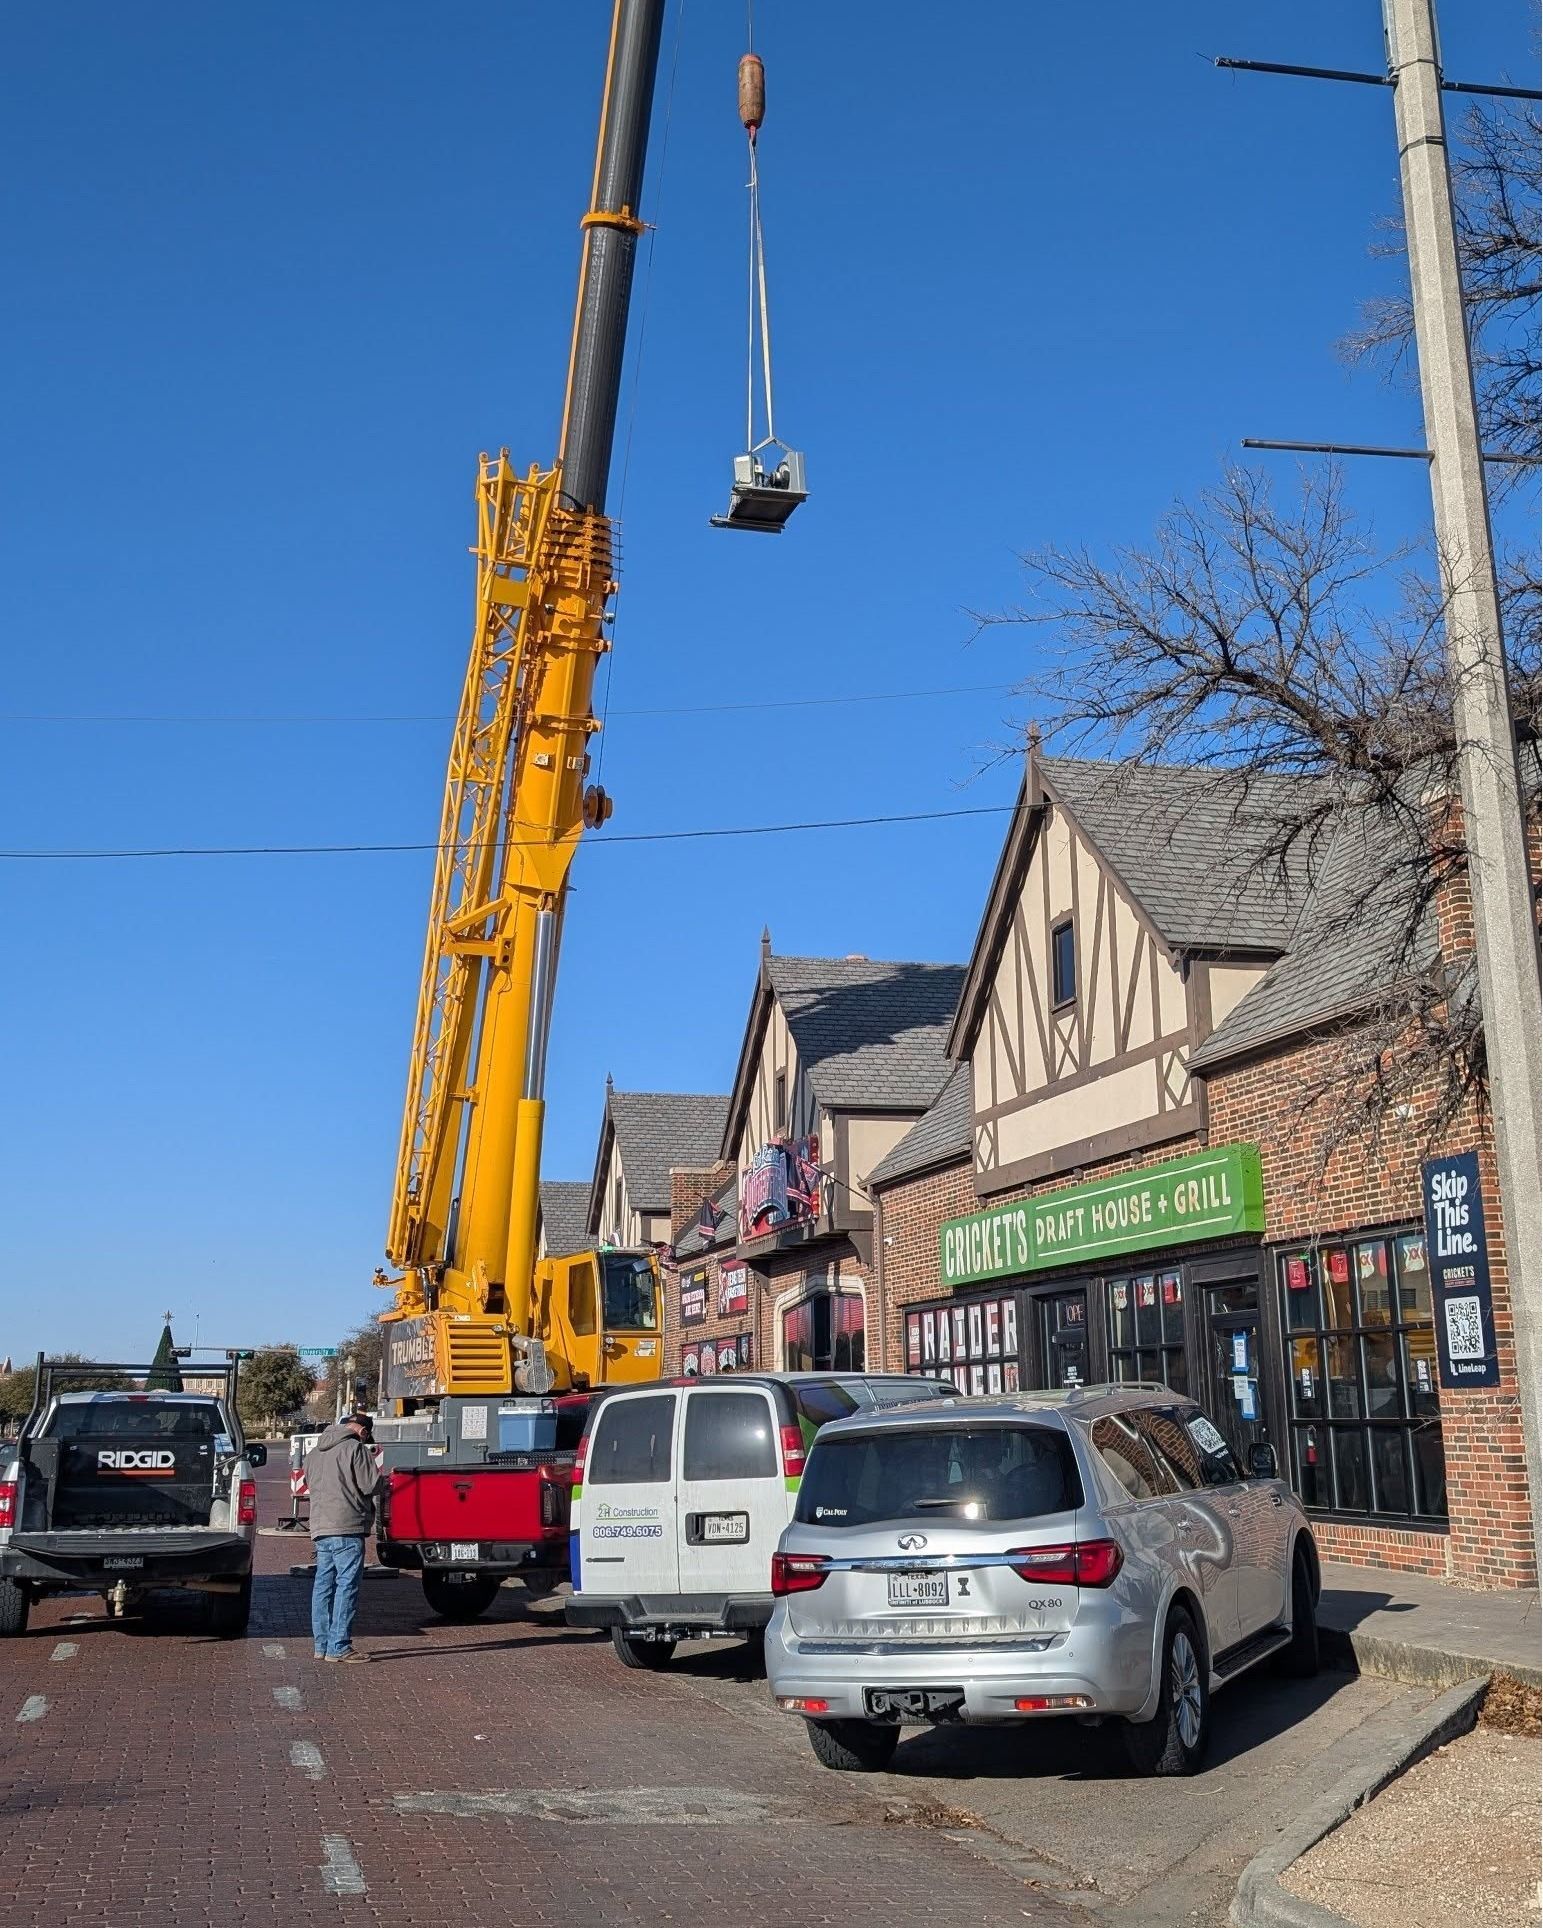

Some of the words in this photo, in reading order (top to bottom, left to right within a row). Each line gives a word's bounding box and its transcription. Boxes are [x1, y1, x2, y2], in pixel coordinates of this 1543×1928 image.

[1432, 1170, 1468, 1202] Skip
[1434, 1198, 1469, 1229] This
[946, 1209, 1028, 1278] CRICKET'S
[1036, 1207, 1085, 1245] DRAFT
[1092, 1192, 1152, 1233] HOUSE
[1174, 1173, 1232, 1215] GRILL
[1438, 1228, 1478, 1257] Line.
[1443, 1265, 1475, 1280] CRICKET'S
[392, 1336, 435, 1366] TRUMBLE
[97, 1450, 175, 1468] RIDGID
[613, 1507, 657, 1517] Construction
[593, 1525, 662, 1538] 806.749.6075
[1029, 1598, 1063, 1611] QX80
